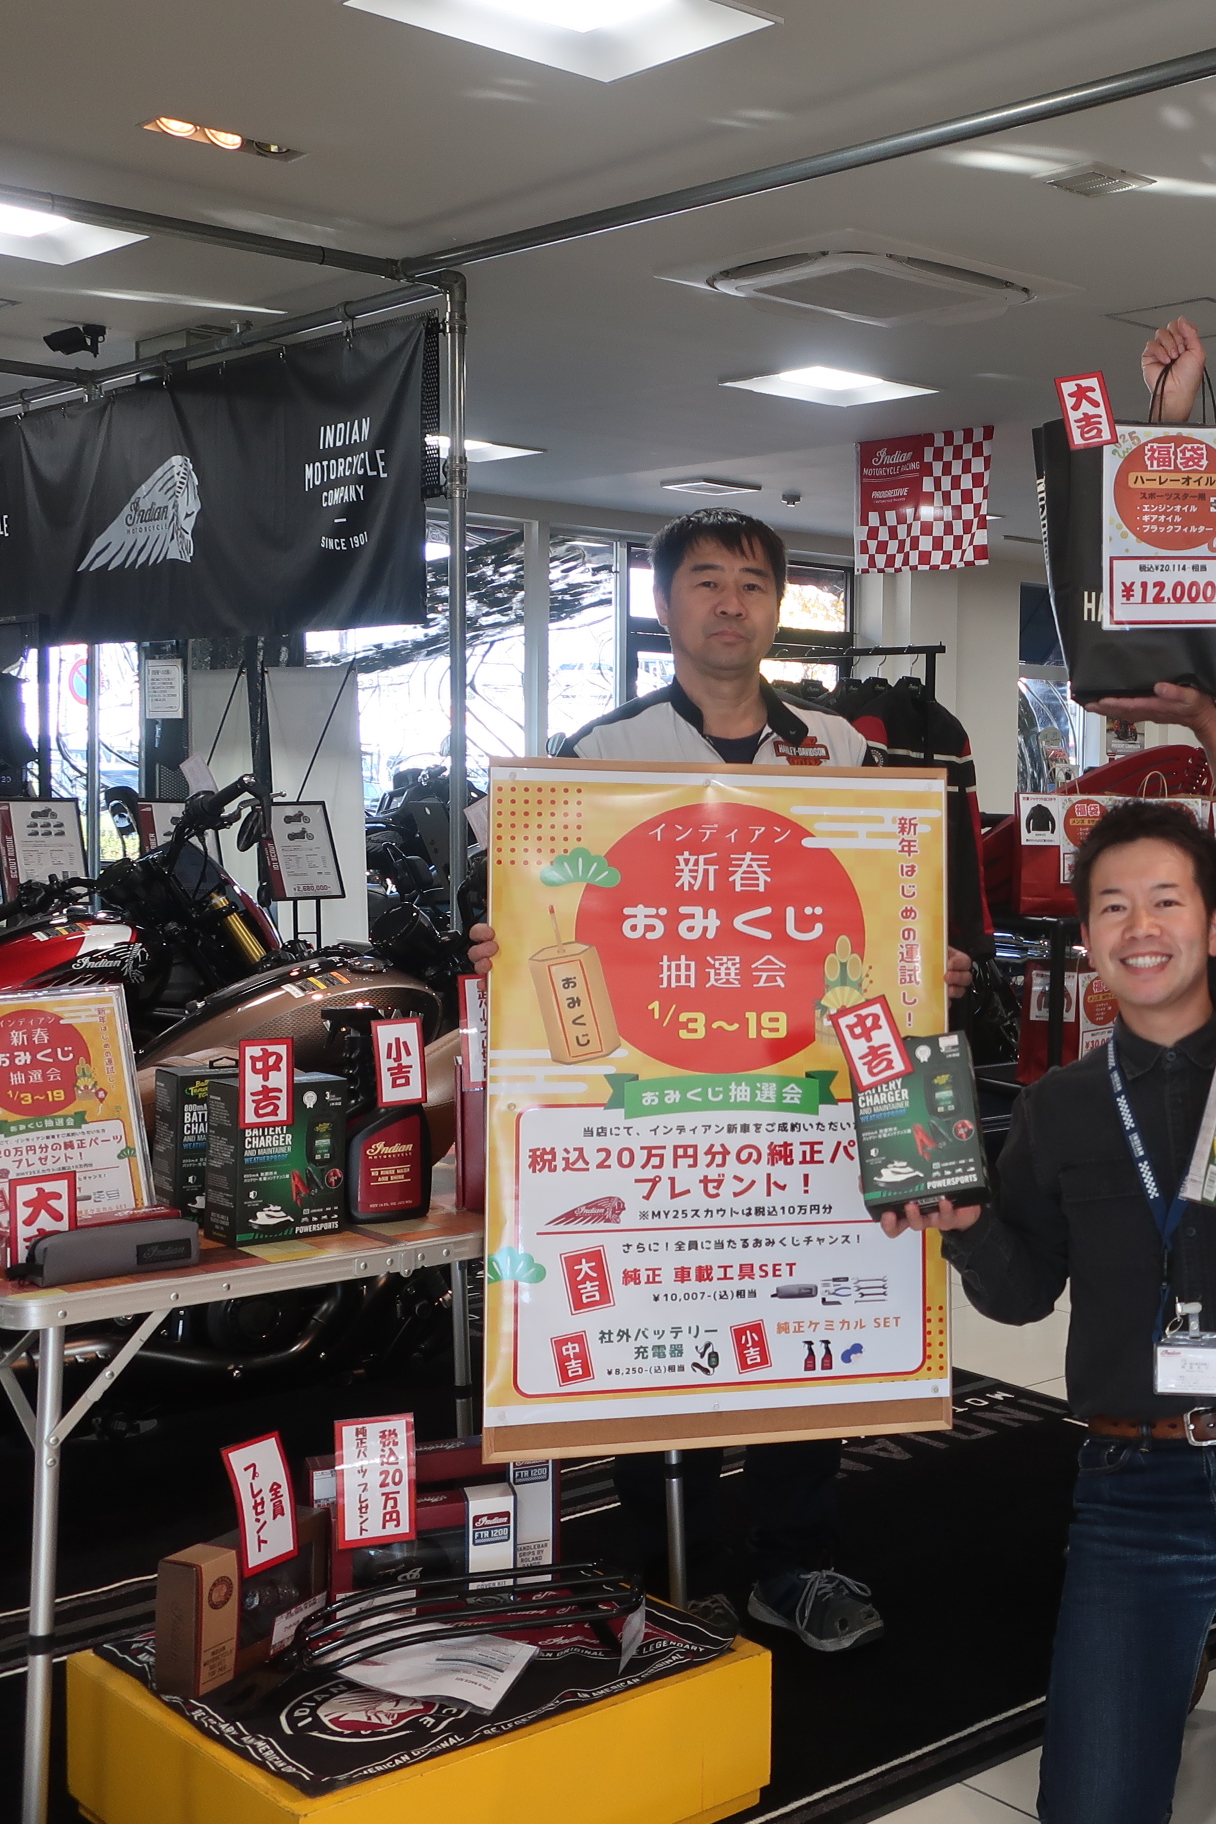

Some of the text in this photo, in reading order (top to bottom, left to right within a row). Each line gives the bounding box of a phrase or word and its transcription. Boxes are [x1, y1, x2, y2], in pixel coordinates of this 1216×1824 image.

[1067, 382, 1104, 442] 大吉
[319, 416, 371, 450] INDIAN
[871, 447, 914, 466] Indian
[1144, 442, 1209, 472] 福袋
[304, 448, 388, 492] MOTORCYCLE
[862, 465, 900, 476] MOTORCYCLE
[1133, 475, 1216, 487] ハーレーオイル
[321, 484, 365, 508] COMPANY
[125, 497, 169, 527] Indian
[126, 523, 170, 535] MOTORCYCLE
[320, 531, 368, 551] SINCE 1901
[1074, 803, 1101, 818] 福袋
[647, 821, 792, 844] インディアン
[674, 850, 773, 893] 新春
[621, 904, 824, 942] おみくじ
[72, 956, 122, 970] Indian
[658, 953, 788, 990] 抽選会
[560, 975, 592, 1048] おみくじ
[10, 1027, 50, 1047] 新春
[846, 1013, 895, 1078] 中吉
[386, 1037, 413, 1090] 小吉
[9, 1067, 62, 1086] 抽選会
[248, 1048, 284, 1119] 中吉
[641, 1081, 803, 1106] おみくじ抽選会
[858, 1089, 909, 1107] CHARGER
[859, 1101, 910, 1116] AND MAINTAINER
[245, 1134, 292, 1149] CHARGER
[366, 1141, 413, 1156] Indian
[1132, 1132, 1145, 1156] INDIAN
[244, 1149, 257, 1157] AND
[633, 1173, 812, 1201] プレゼント！
[926, 1173, 978, 1190] POWERSPORTS
[574, 1205, 606, 1215] Indian
[638, 1203, 834, 1222] ※MY25スカウトは税込10万円分
[295, 1221, 339, 1234] POWERSPORTS
[572, 1258, 601, 1305] 大吉
[621, 1262, 797, 1286] 純正 車載工具SET
[598, 1325, 719, 1344] 社外バッテリー
[776, 1316, 902, 1335] 純正ケミカル SET
[633, 1344, 685, 1360] 充電器
[740, 1329, 762, 1366] 小吉
[562, 1341, 583, 1378] 中吉
[378, 1428, 404, 1530] 税込20万円
[515, 1467, 547, 1481] FTR 1200
[243, 1462, 268, 1553] プレゼント
[268, 1481, 286, 1521] 全員
[474, 1515, 509, 1527] Indian
[475, 1527, 509, 1540] FTR 1200
[520, 1556, 543, 1564] ROLAND
